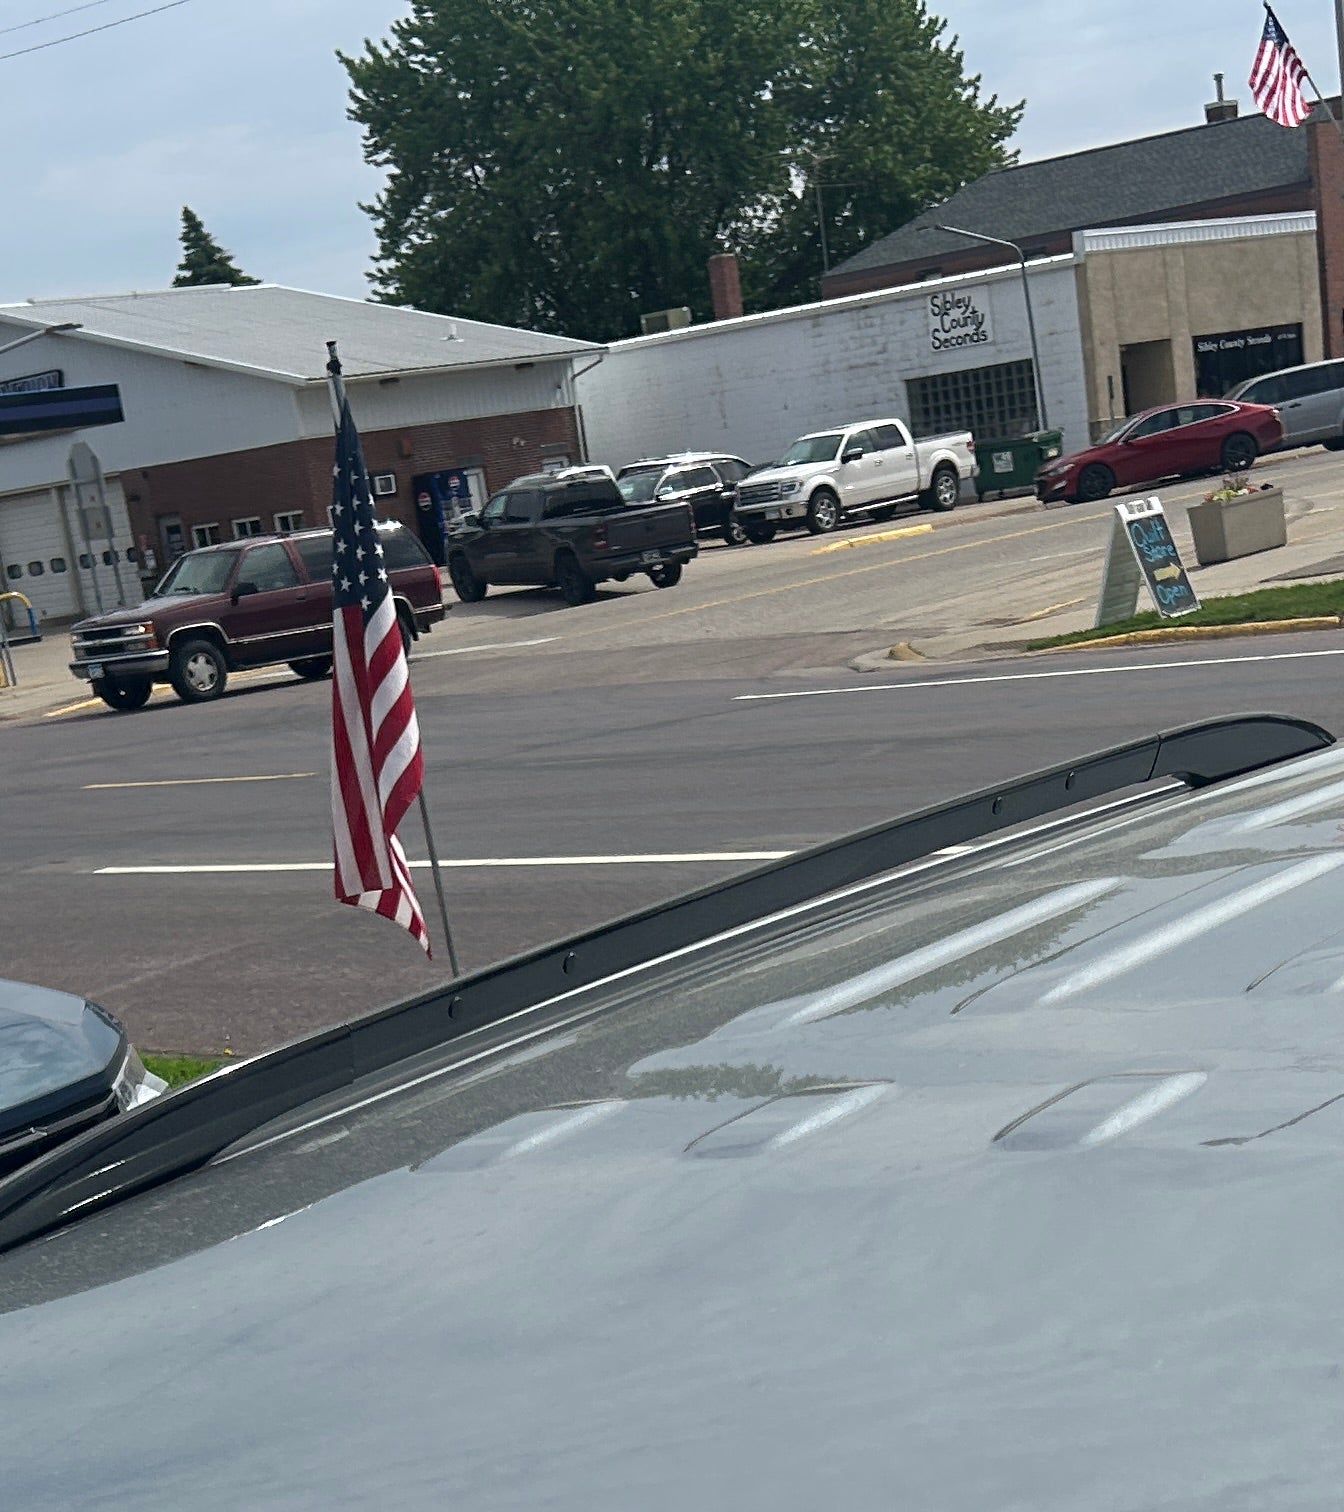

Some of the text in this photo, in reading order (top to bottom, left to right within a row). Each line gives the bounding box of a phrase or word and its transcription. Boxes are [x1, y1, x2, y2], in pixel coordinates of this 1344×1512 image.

[940, 305, 985, 334] County
[931, 327, 989, 350] Seconds
[1156, 584, 1190, 606] Open
